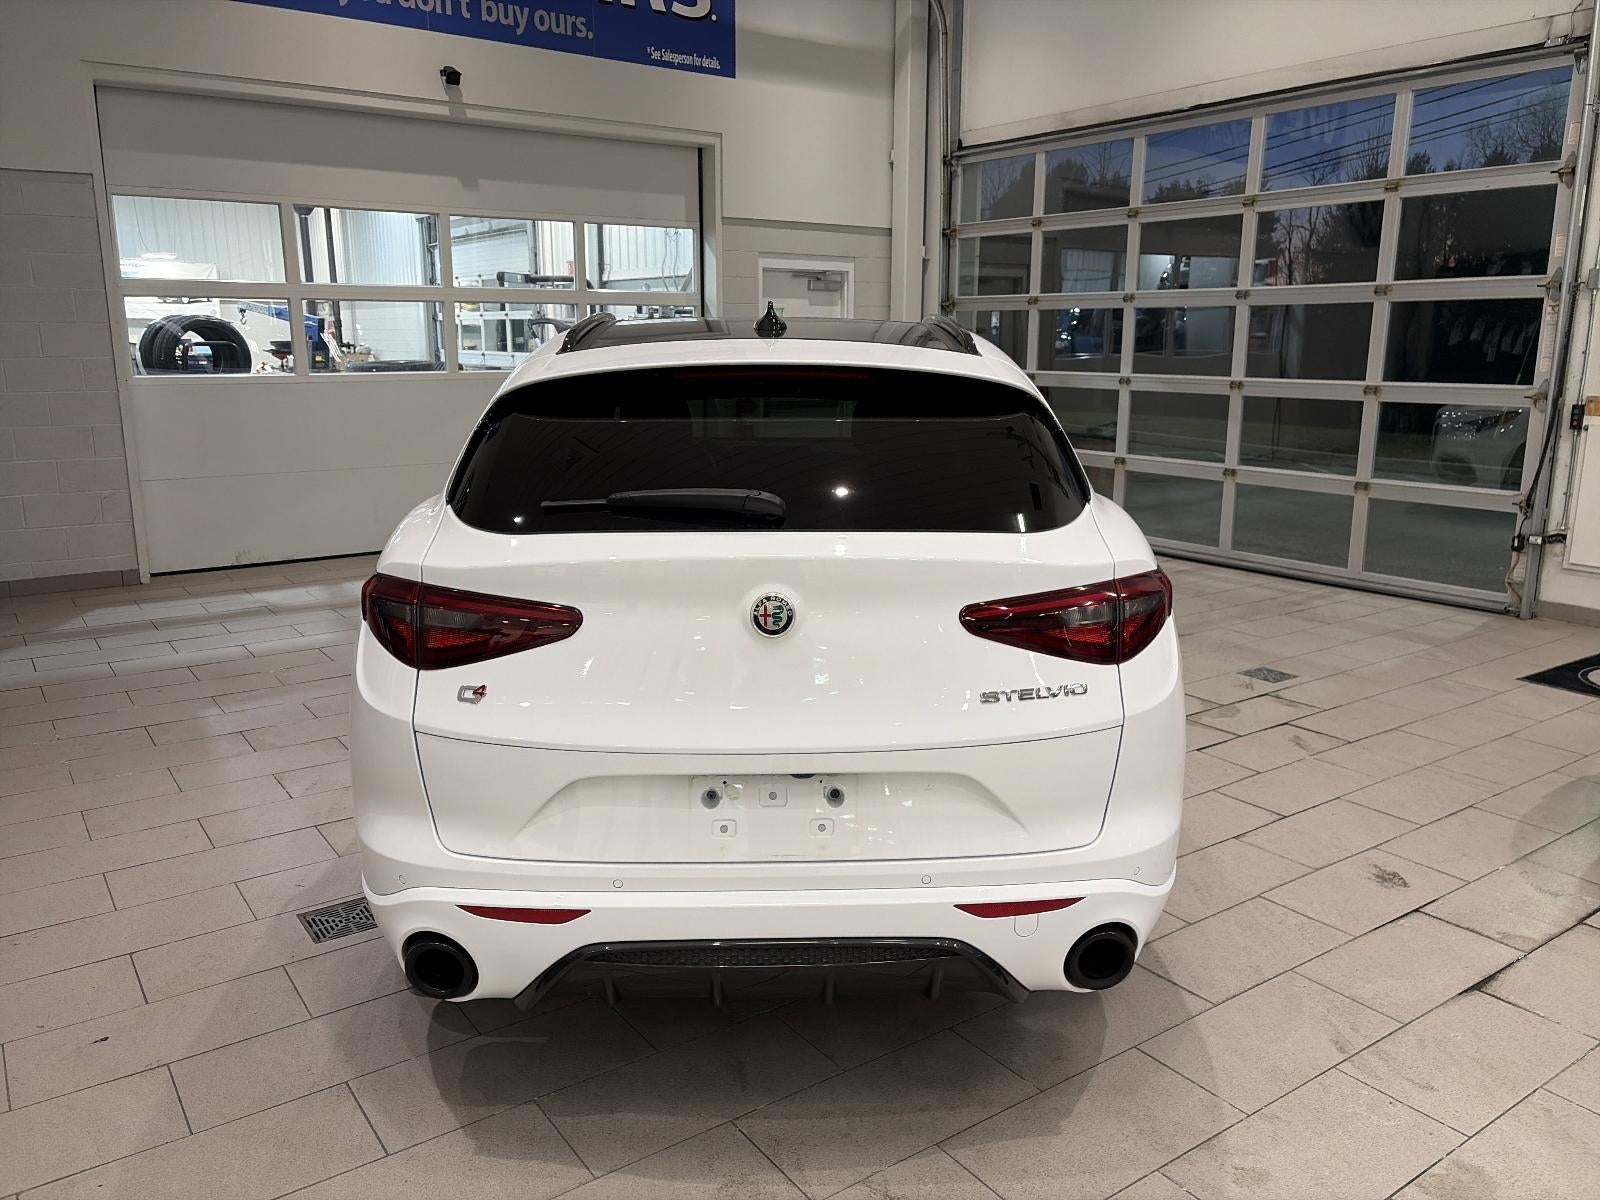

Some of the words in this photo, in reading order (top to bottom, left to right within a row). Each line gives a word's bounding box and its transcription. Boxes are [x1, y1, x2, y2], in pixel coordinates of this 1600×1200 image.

[481, 0, 530, 36] buy
[533, 8, 594, 40] ours.
[662, 49, 694, 66] Salesperson
[694, 53, 702, 67] for
[702, 55, 720, 69] details.
[752, 599, 768, 615] ALFA
[770, 596, 793, 616] ROMEO
[980, 683, 1088, 703] STELVIO
